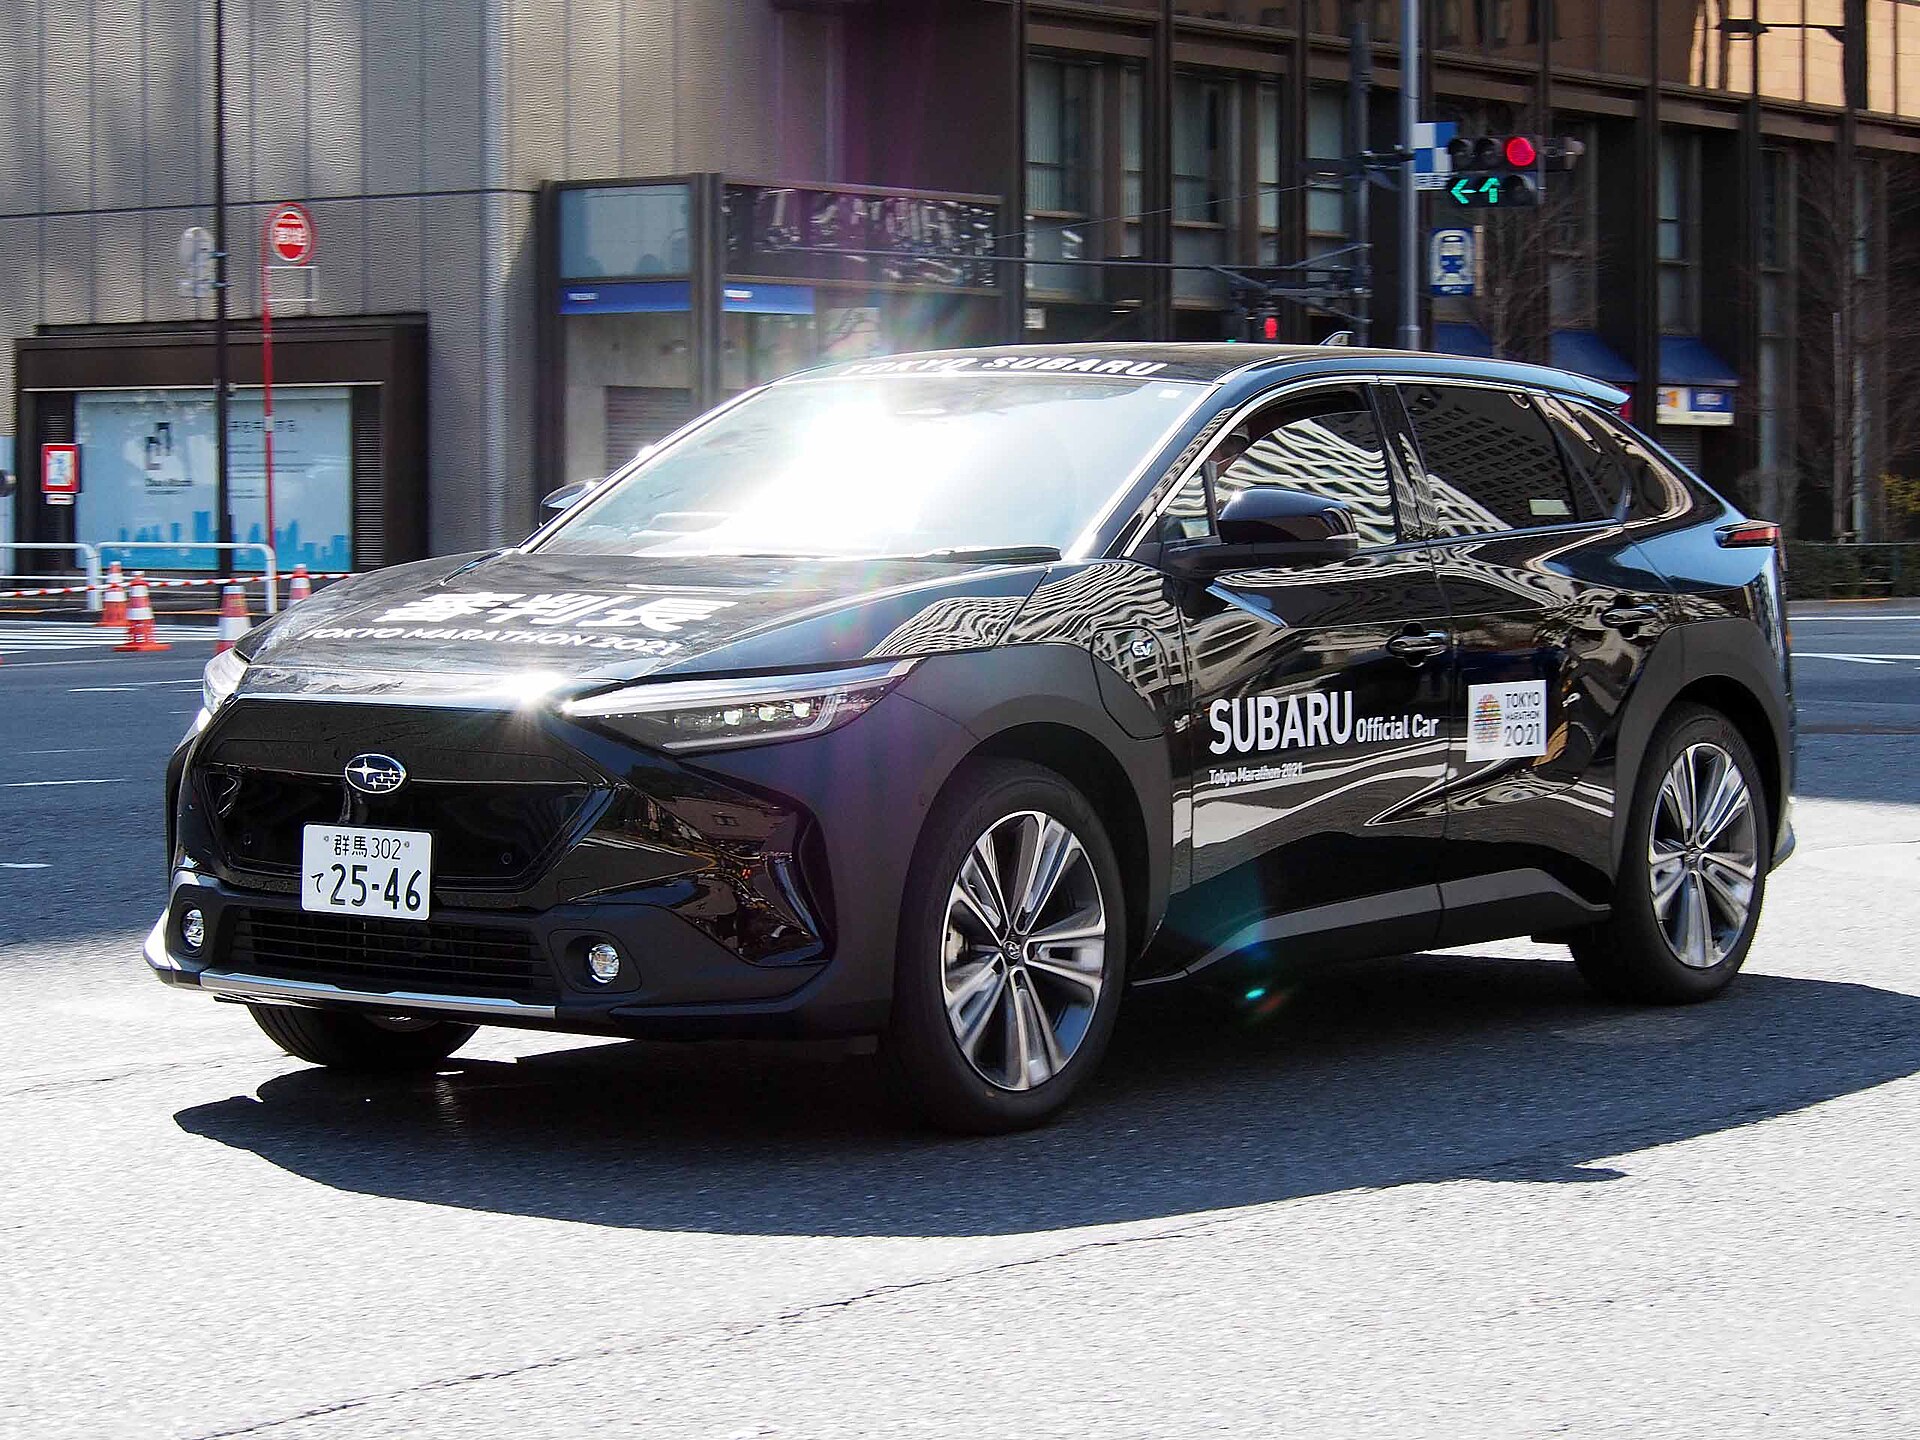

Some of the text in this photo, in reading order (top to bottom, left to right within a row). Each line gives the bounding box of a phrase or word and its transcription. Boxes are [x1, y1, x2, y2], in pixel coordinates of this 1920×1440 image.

[838, 356, 1168, 377] TOKYO SUBARU
[371, 591, 739, 632] 審判長
[298, 628, 684, 656] TOKYO MARATHON 2021
[1504, 691, 1541, 709] TOKYO
[1208, 690, 1440, 755] SUBARU Official Car
[1503, 722, 1541, 748] 2021
[1209, 762, 1303, 787] Tokyo Marathon 2021
[329, 863, 422, 911] 25-46
